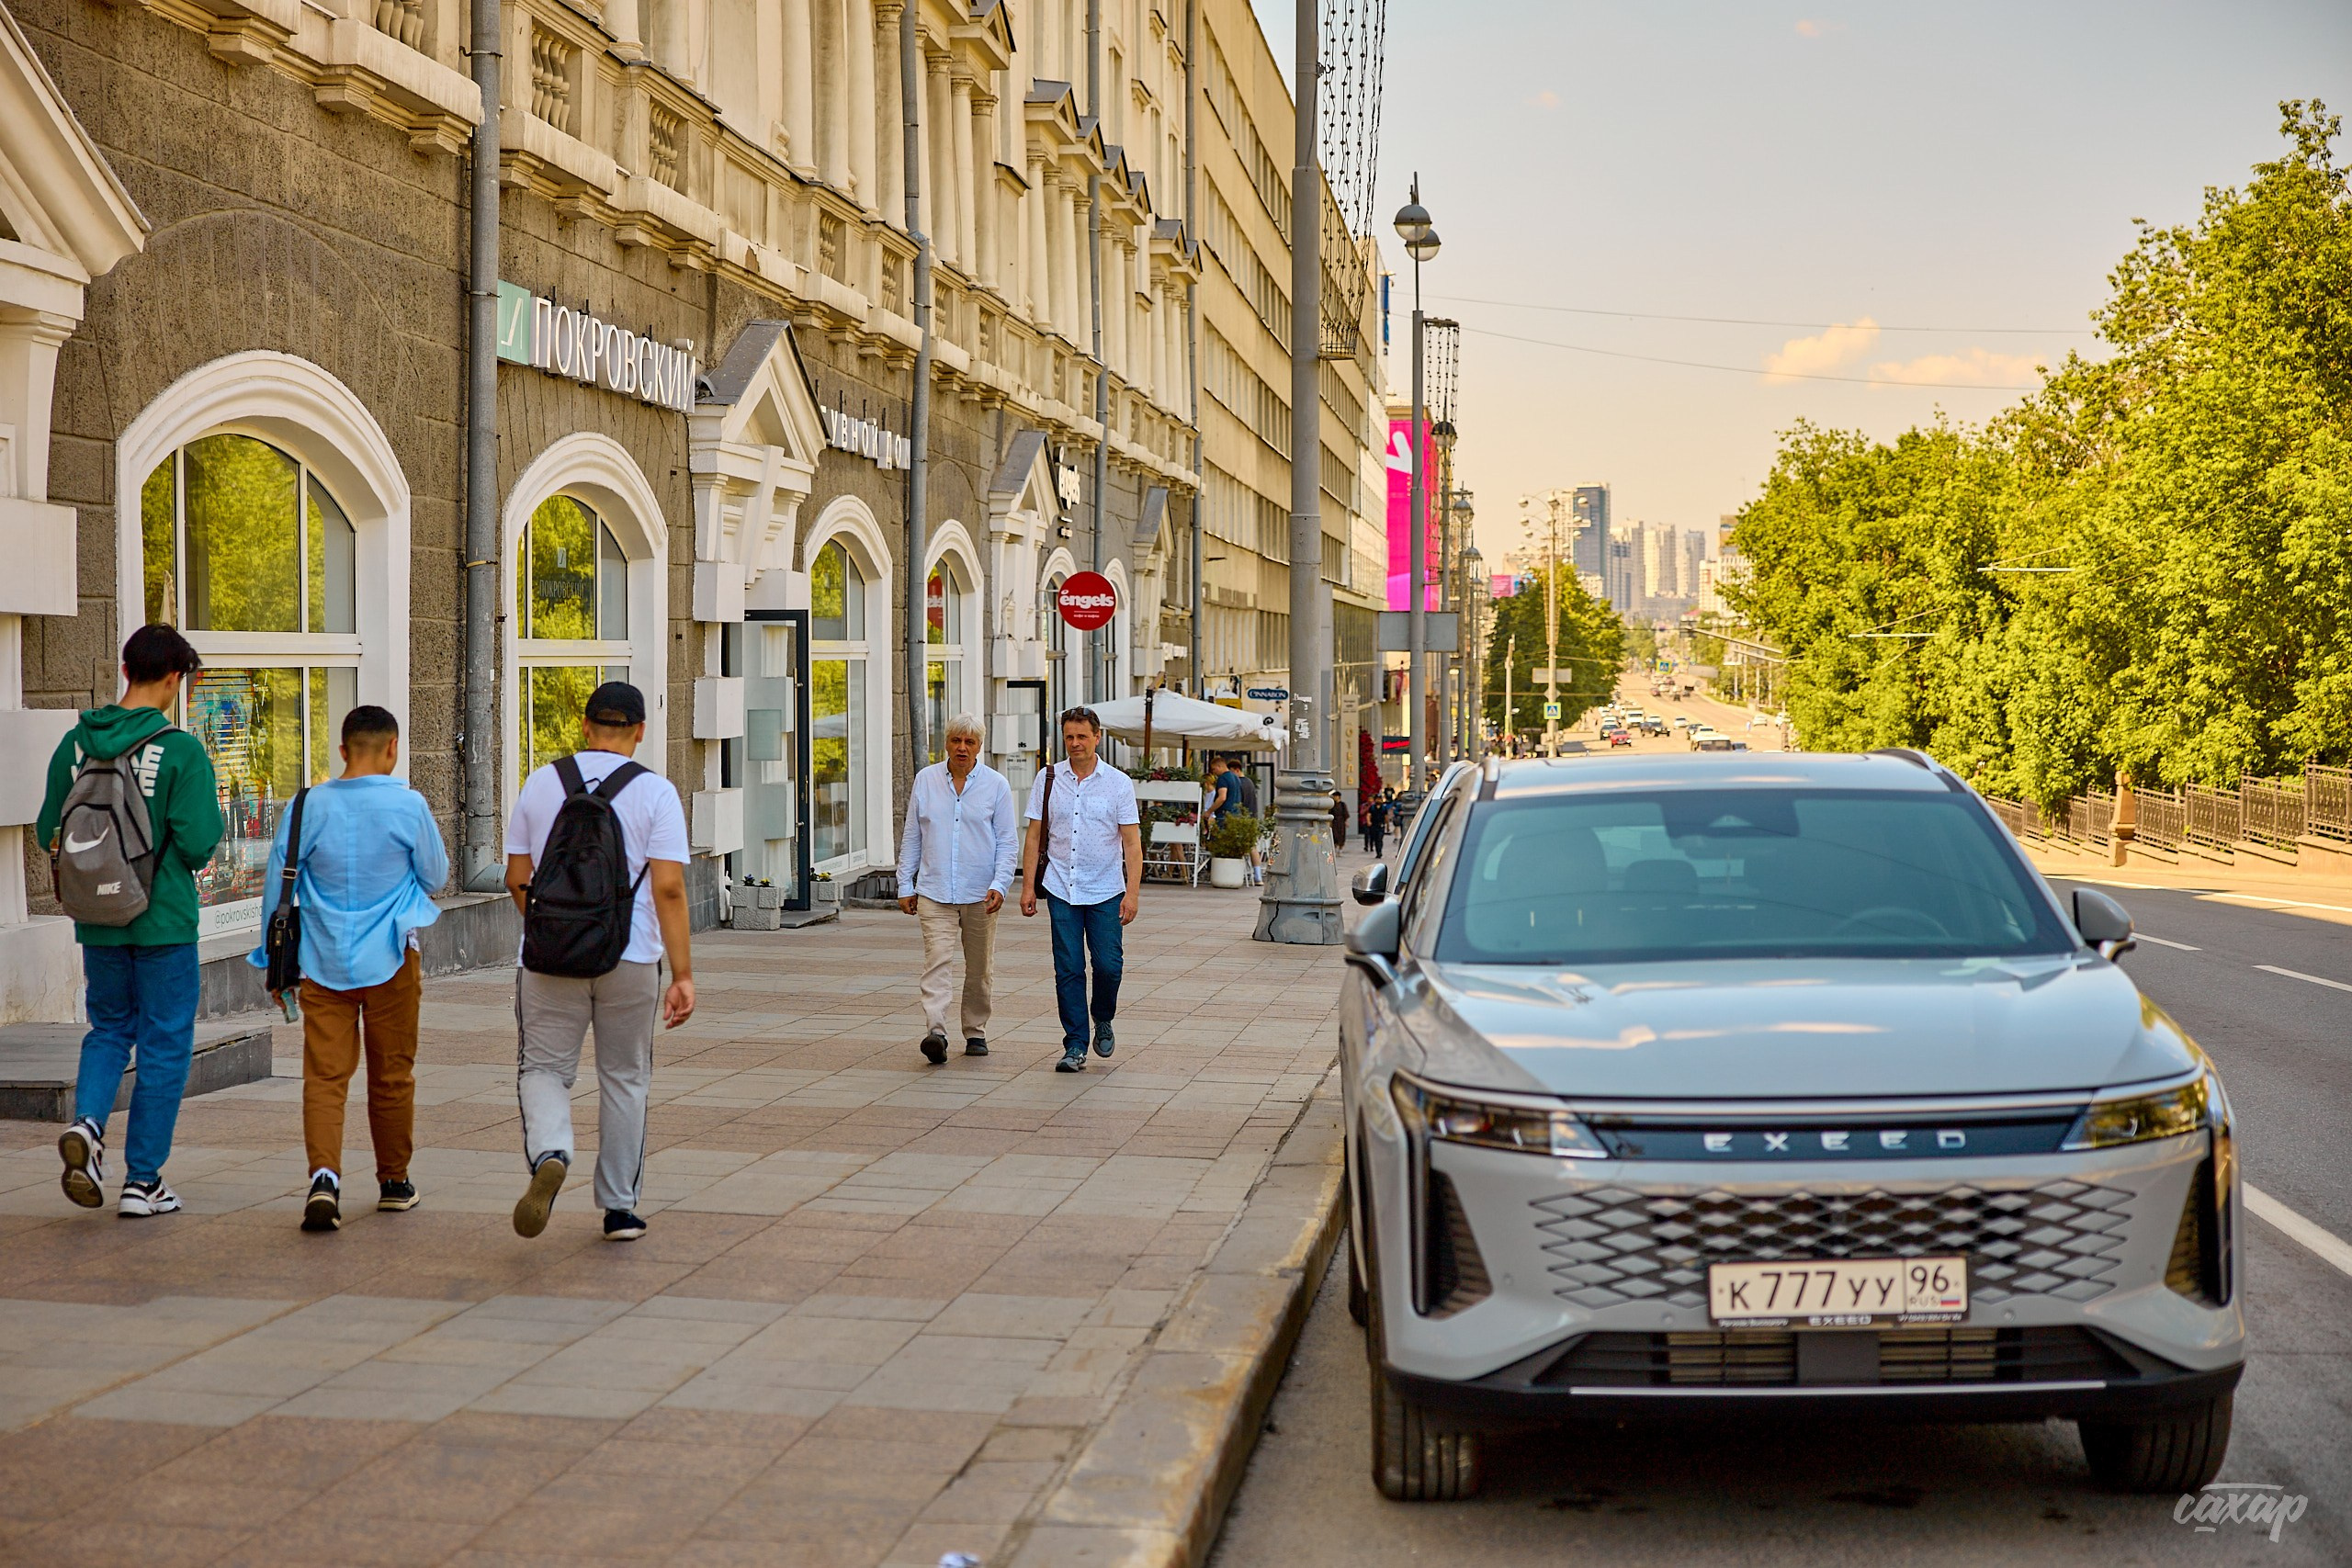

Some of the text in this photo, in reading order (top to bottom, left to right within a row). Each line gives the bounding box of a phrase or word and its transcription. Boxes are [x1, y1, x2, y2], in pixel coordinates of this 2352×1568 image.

[534, 296, 696, 412] ПОКРОВСКИЙ
[820, 405, 878, 459] УВНОЙ
[96, 881, 121, 896] NIKE
[1702, 1130, 1966, 1152] EXEED
[1910, 1265, 1950, 1295] 96
[1808, 1314, 1871, 1326] EXEED
